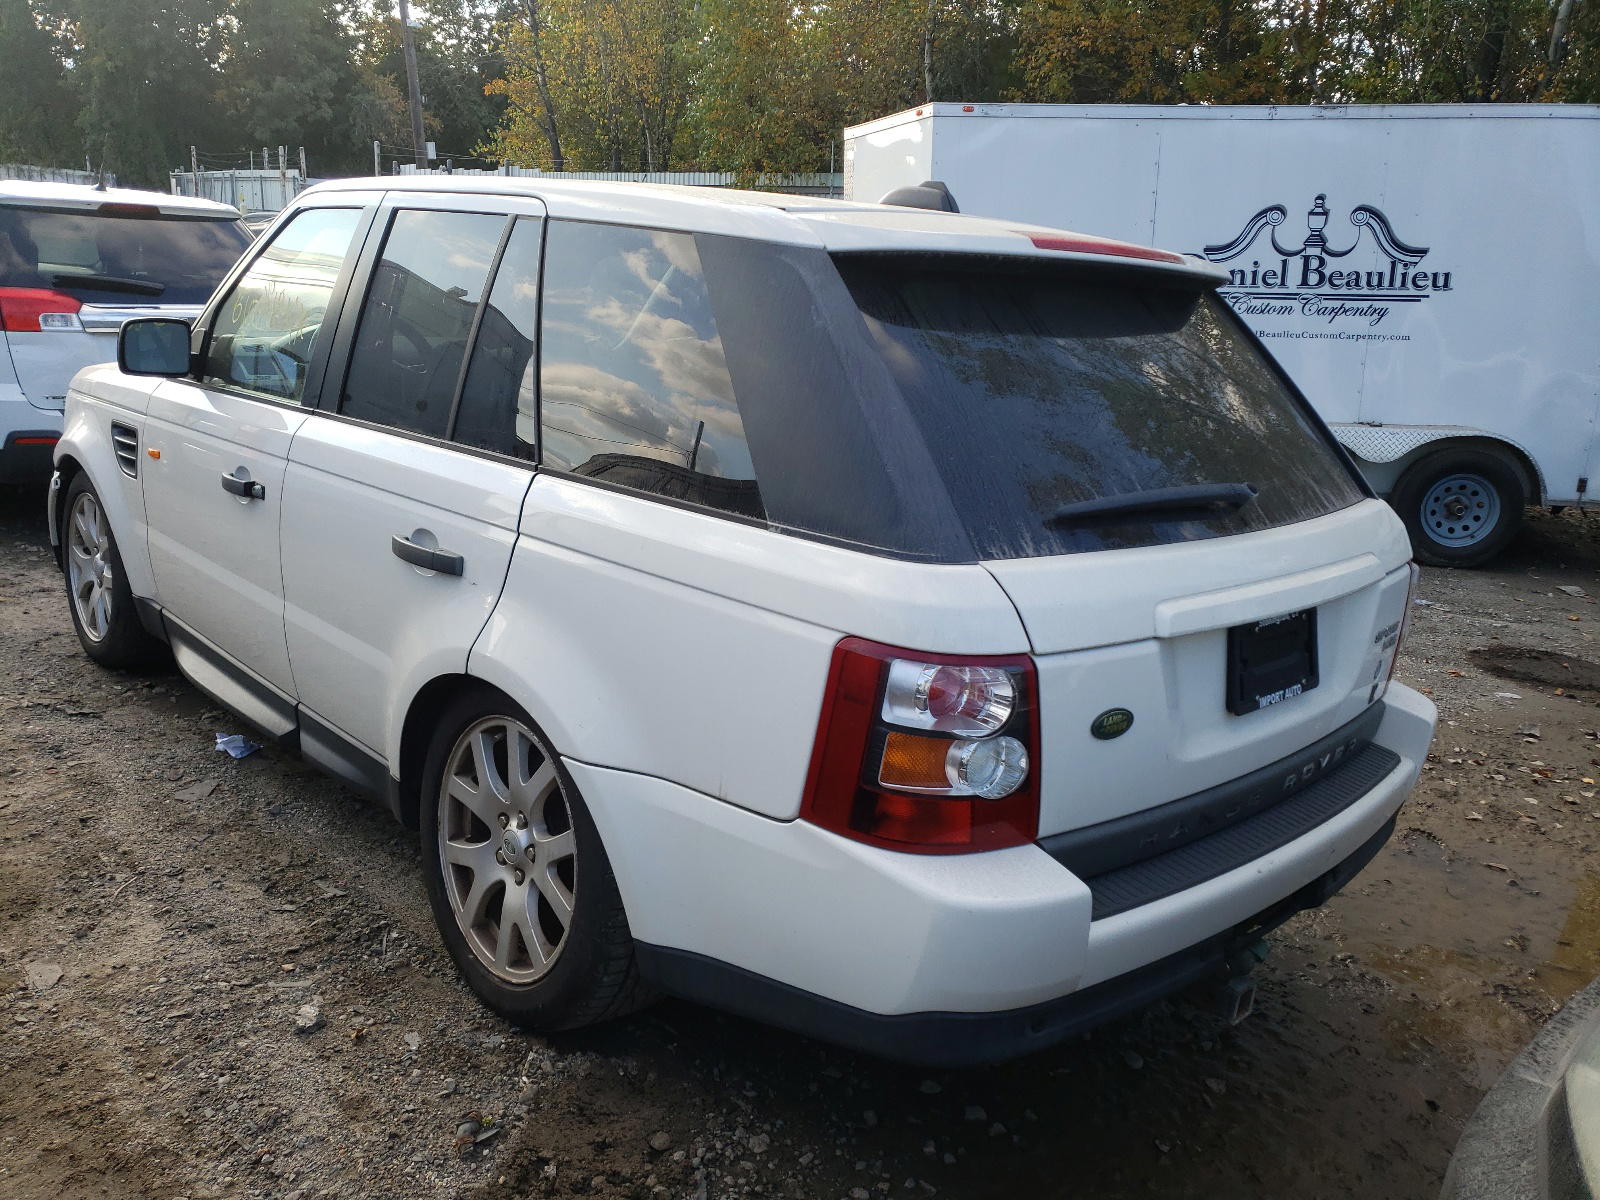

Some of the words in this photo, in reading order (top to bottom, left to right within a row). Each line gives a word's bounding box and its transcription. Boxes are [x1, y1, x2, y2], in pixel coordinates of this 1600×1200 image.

[1228, 258, 1288, 288] niel
[1297, 254, 1452, 291] Beaulieu
[1228, 292, 1295, 315] Custom
[1298, 293, 1390, 326] Carpentry
[1255, 330, 1411, 343] lBeaulieuCustomCarpentry.com
[1259, 690, 1284, 709] IMPORT
[1285, 684, 1302, 701] AUTO
